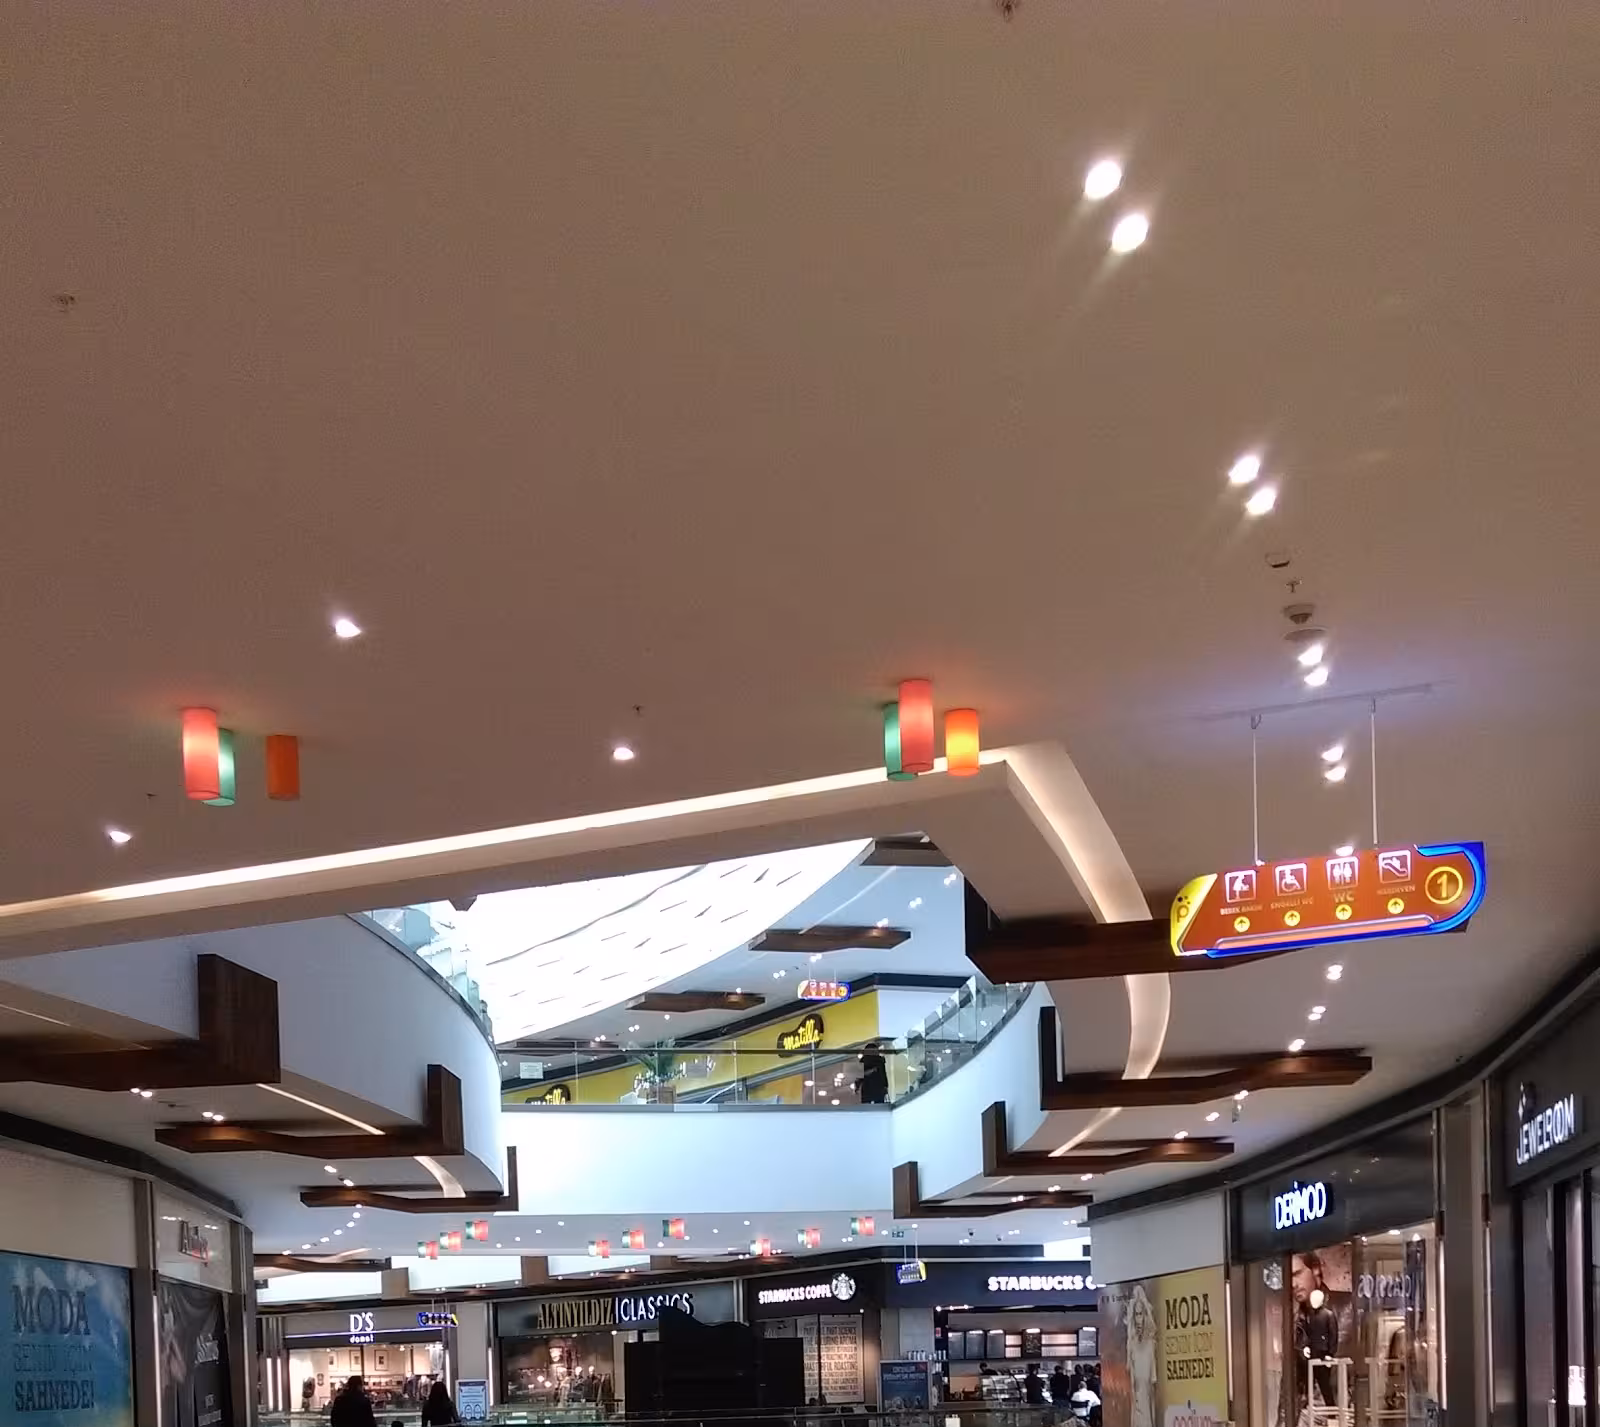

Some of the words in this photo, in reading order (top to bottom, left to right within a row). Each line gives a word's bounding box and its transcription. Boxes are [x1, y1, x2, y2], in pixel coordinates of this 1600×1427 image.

[1333, 891, 1355, 903] WC
[1437, 873, 1448, 898] 1
[758, 1286, 805, 1304] STARBUCKS
[988, 1275, 1084, 1291] STARBUCKS
[13, 1284, 91, 1335] MODA
[350, 1311, 374, 1332] D'S
[537, 1297, 613, 1329] ALTINYILDIZ
[1165, 1293, 1212, 1330] MODA
[1166, 1357, 1214, 1380] SAHNEDE!
[15, 1379, 95, 1412] SAHNEDE!
